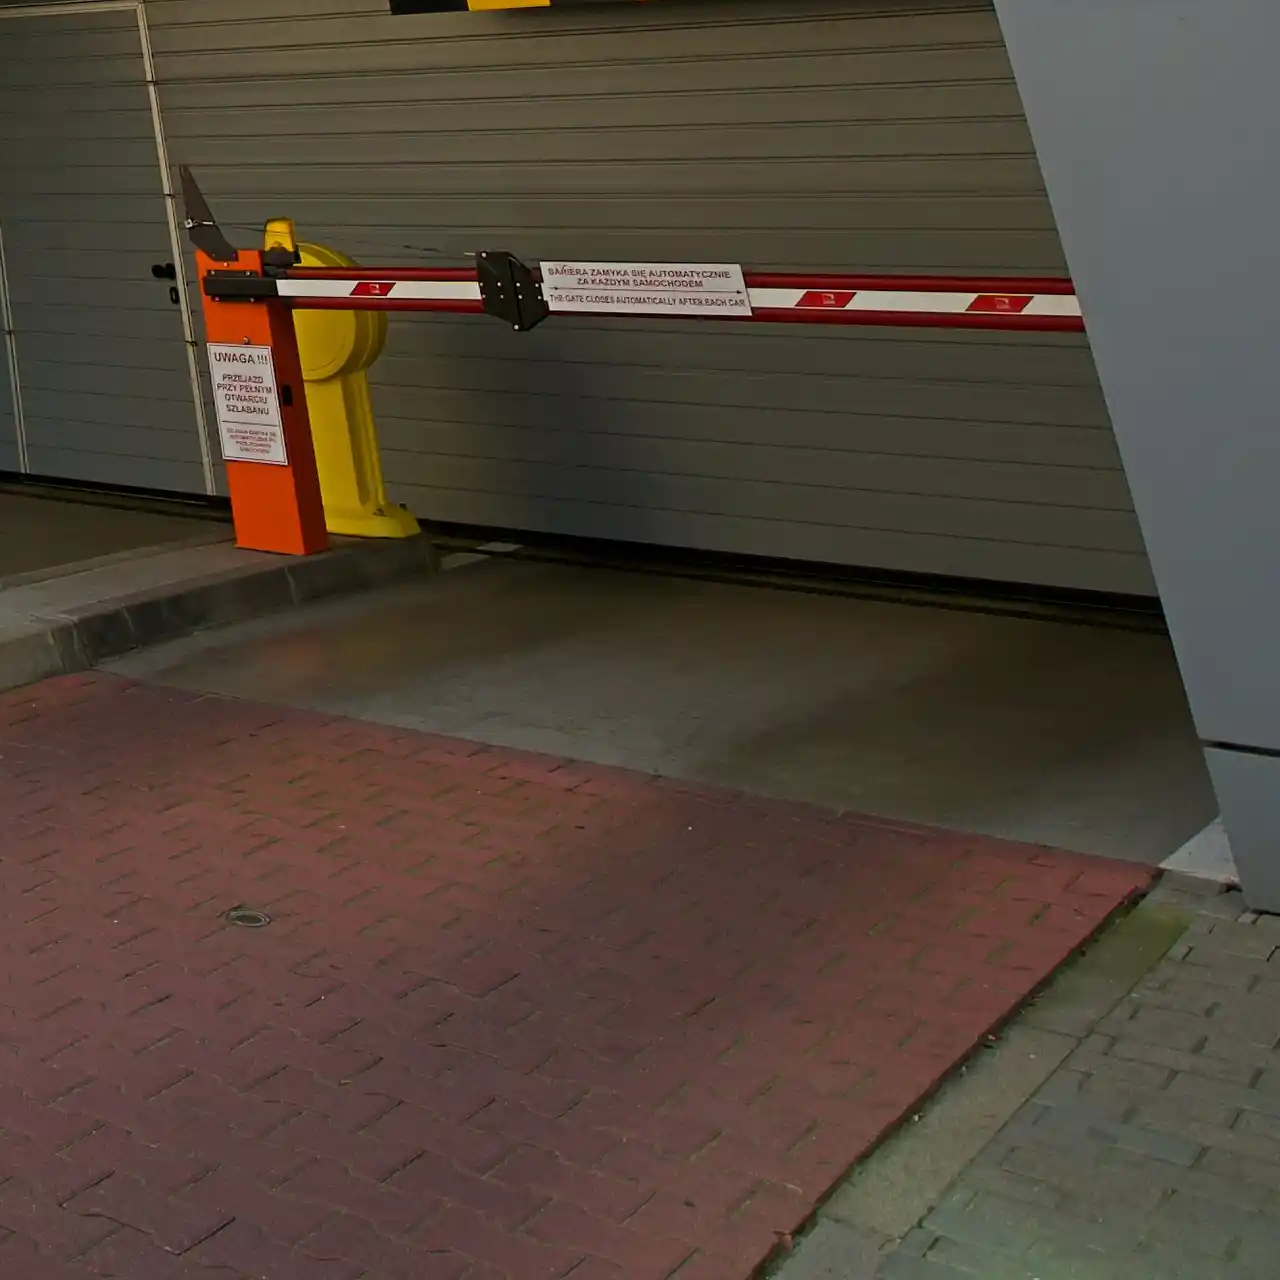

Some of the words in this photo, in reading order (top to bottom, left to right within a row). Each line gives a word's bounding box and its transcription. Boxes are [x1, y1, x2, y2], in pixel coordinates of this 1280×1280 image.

[590, 268, 630, 277] ZAMYKA
[648, 270, 732, 279] AUTOMATYCZNIE
[632, 279, 704, 288] SAMOCHODEM
[213, 351, 256, 365] UWAGA
[257, 354, 268, 365] !!!
[222, 373, 264, 384] PRZEJAZD
[216, 382, 237, 392] PRZY
[224, 393, 268, 405] OTWARCIU
